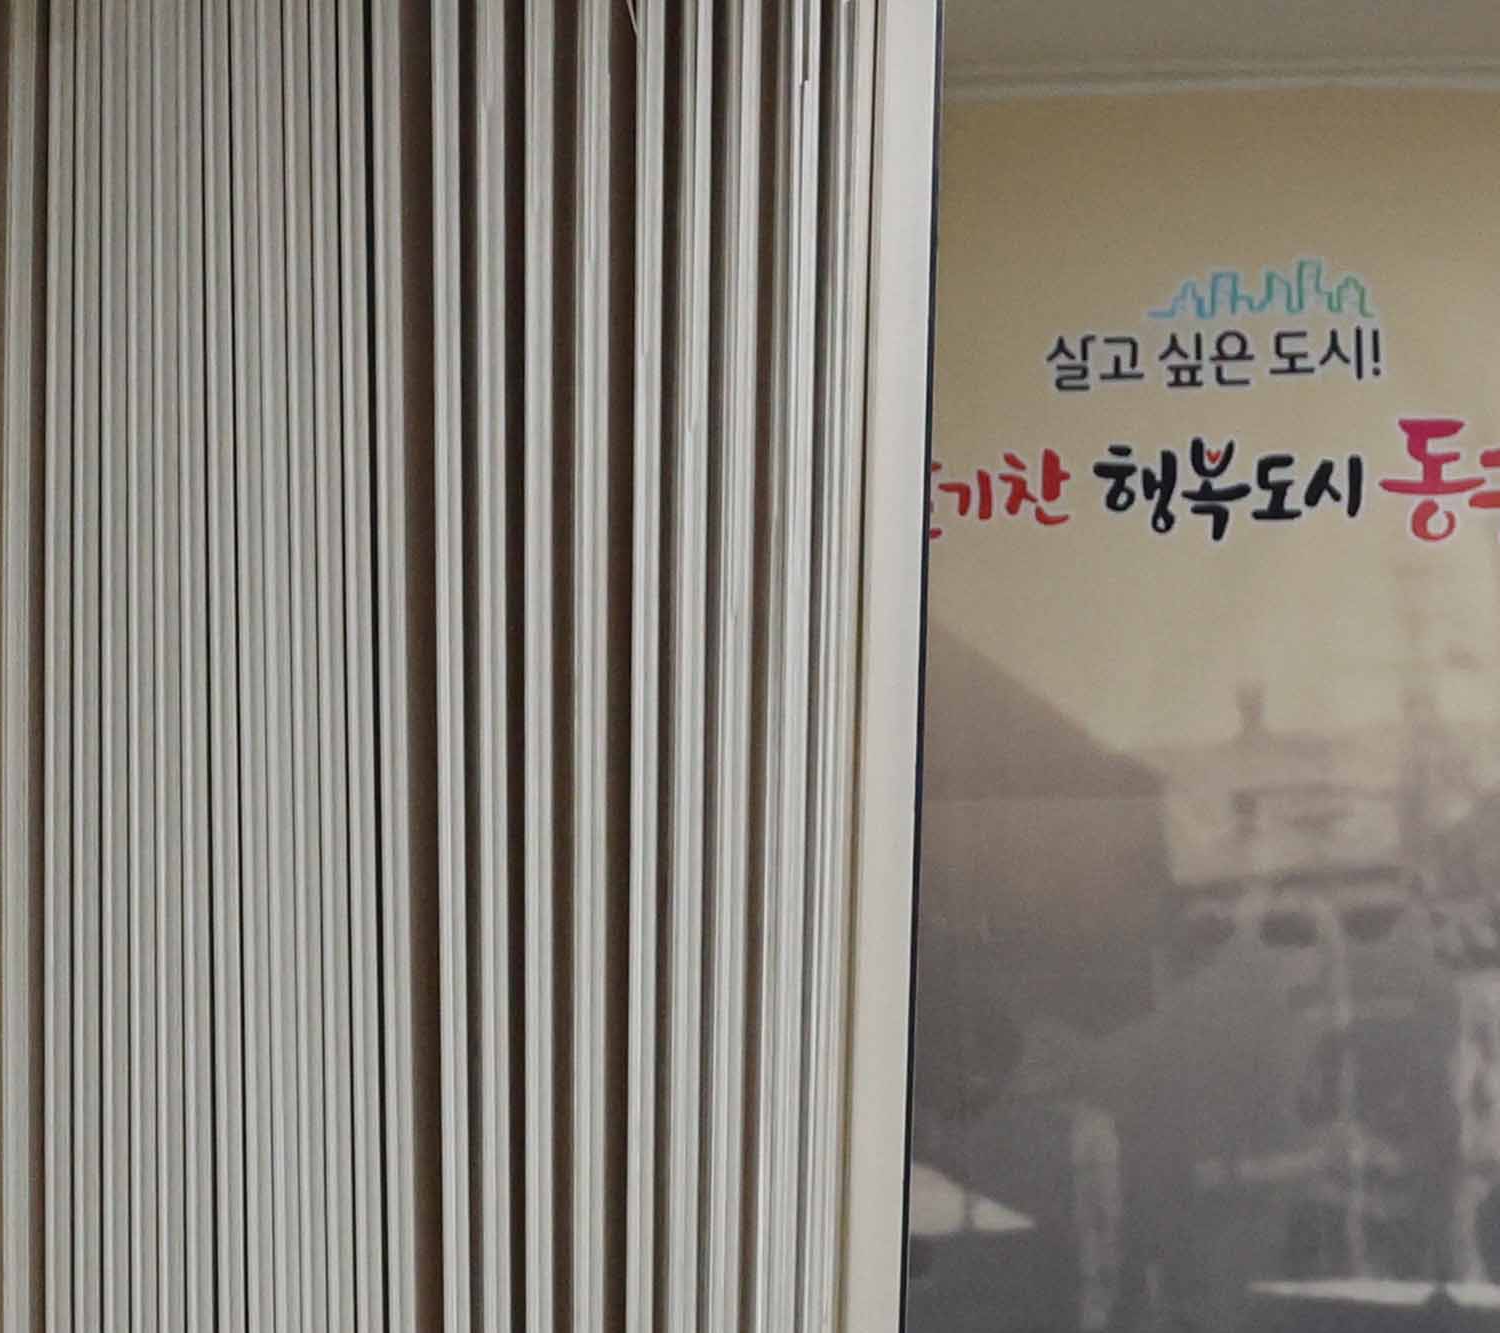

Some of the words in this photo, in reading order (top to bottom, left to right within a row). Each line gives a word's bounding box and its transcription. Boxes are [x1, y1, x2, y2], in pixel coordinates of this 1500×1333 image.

[1046, 333, 1144, 391] 살고
[1158, 331, 1255, 388] 싶은
[1268, 327, 1381, 381] 도시!
[930, 447, 1070, 539] 기찬
[1092, 437, 1364, 541] 행복도시
